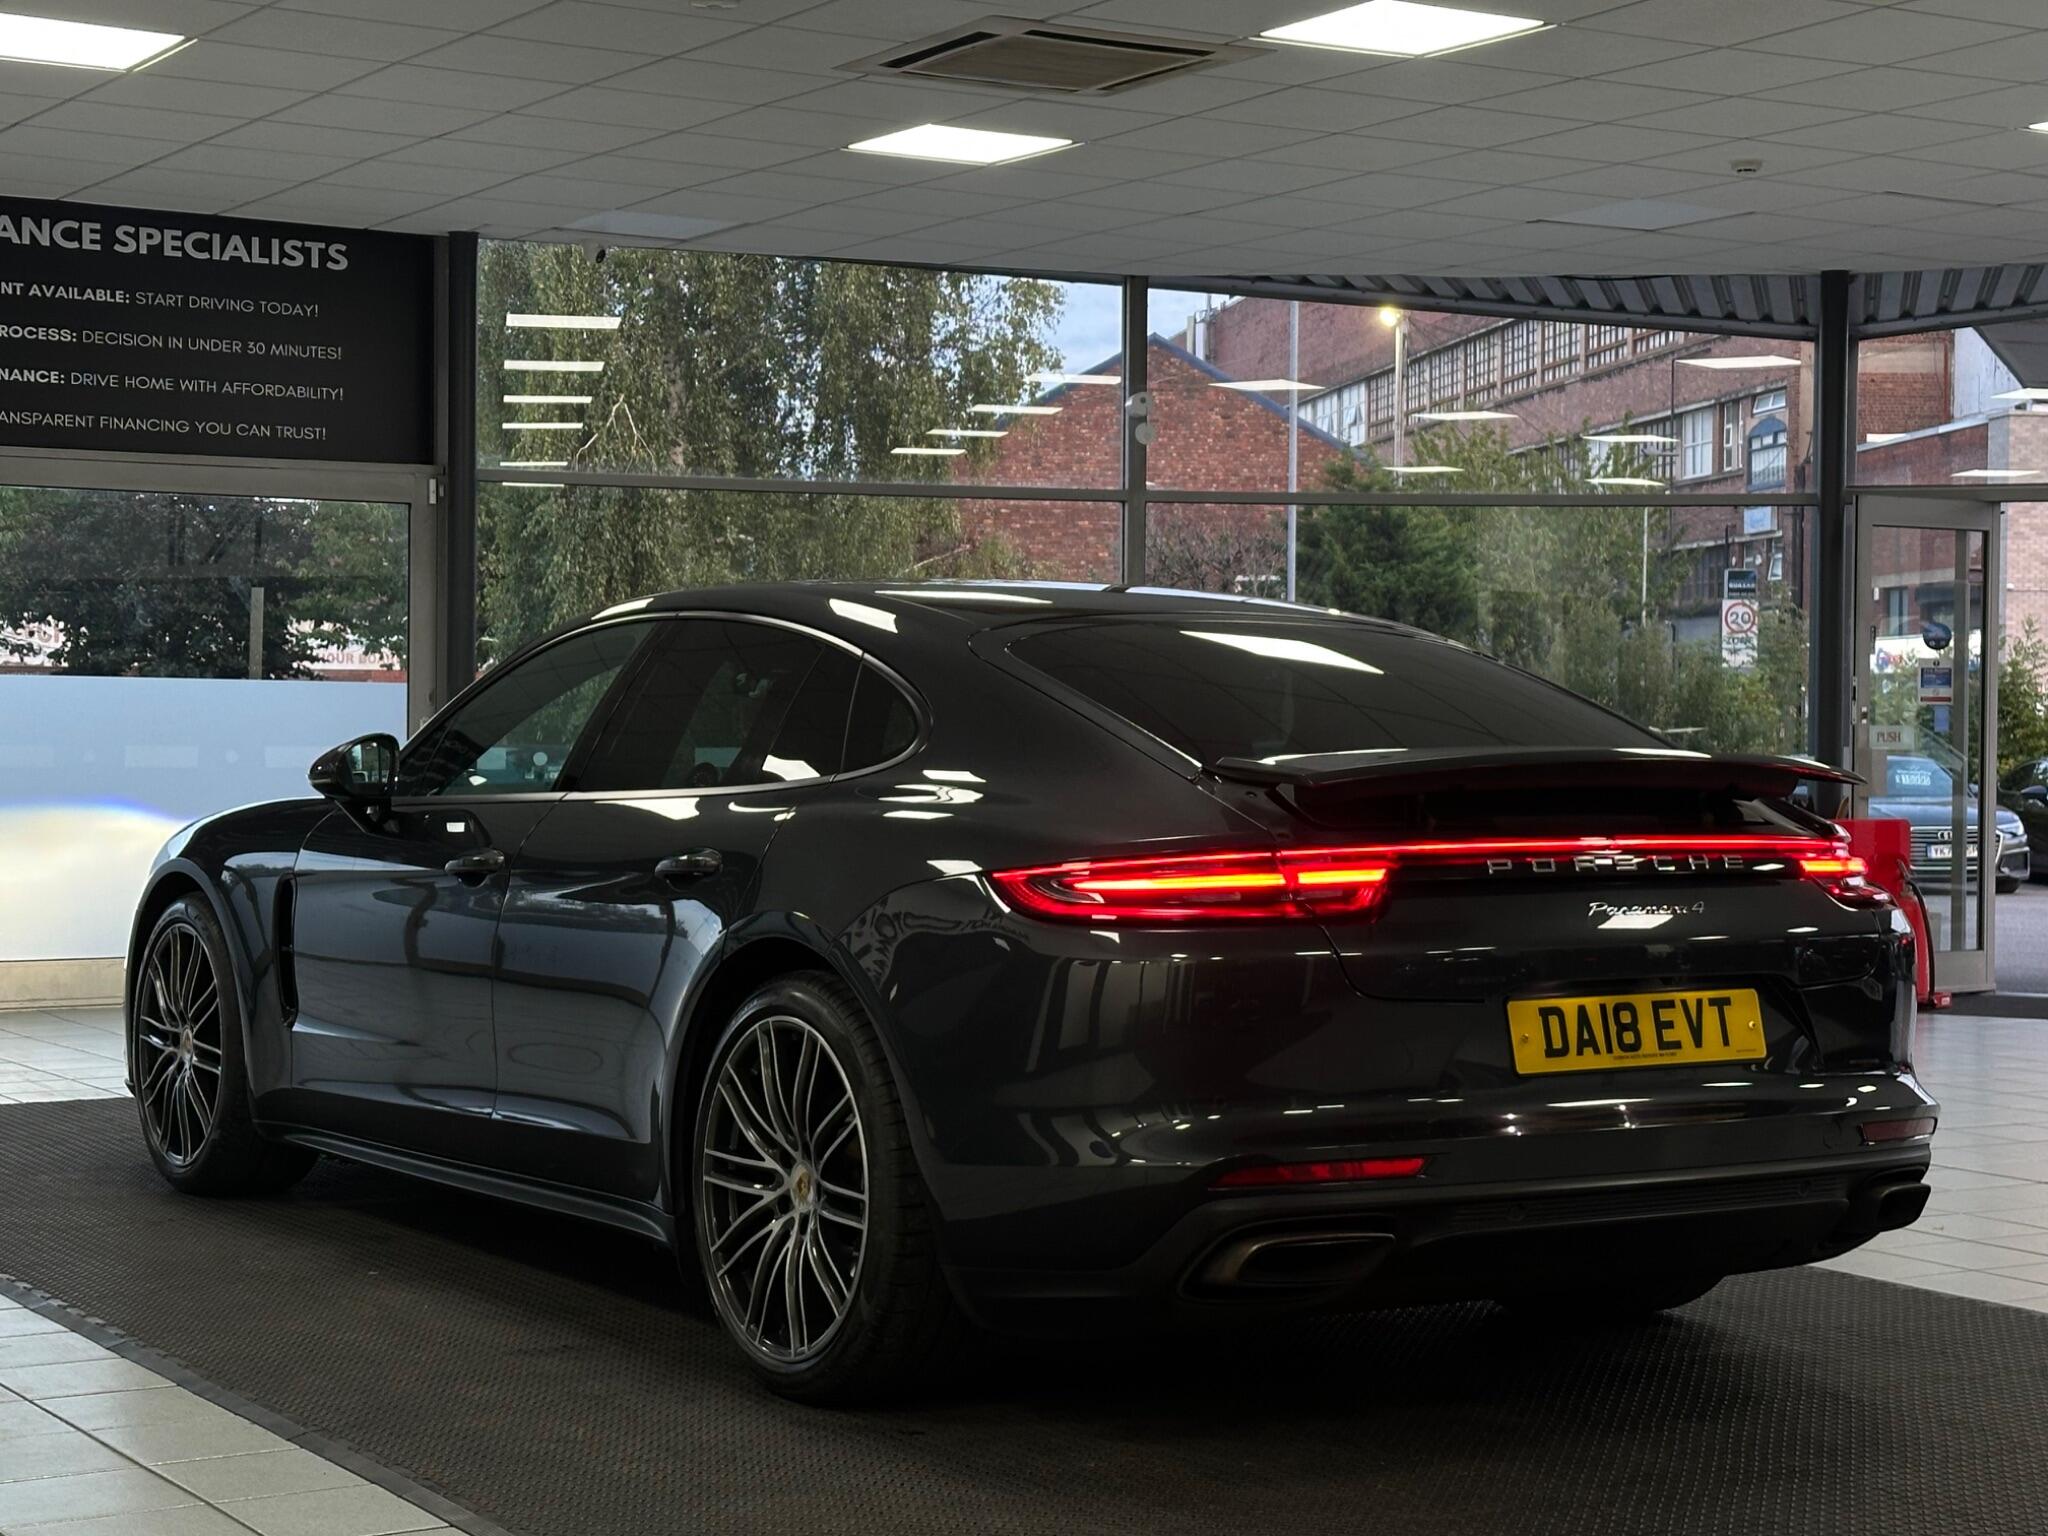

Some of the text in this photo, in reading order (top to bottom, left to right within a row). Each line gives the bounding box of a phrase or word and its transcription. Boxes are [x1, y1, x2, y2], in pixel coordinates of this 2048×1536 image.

[0, 214, 349, 271] ANCE SPECIALISTS
[0, 281, 319, 317] NT AVAILABLE: START DRIVING TODAY!
[0, 325, 342, 360] ROCESS: DECISION IN UNDER 30 MINUTES!
[0, 368, 344, 401] NANCE: DRIVE HOME WITH AFFORDABILITY!
[0, 410, 326, 440] ANSPARENT FINANCING YOU CAN TRUST!
[1729, 611, 1751, 624] 20
[1876, 731, 1901, 743] PUSH
[1487, 854, 1744, 875] PORSCHE
[1691, 901, 1705, 914] 4
[1538, 997, 1732, 1058] DA18 EVT
